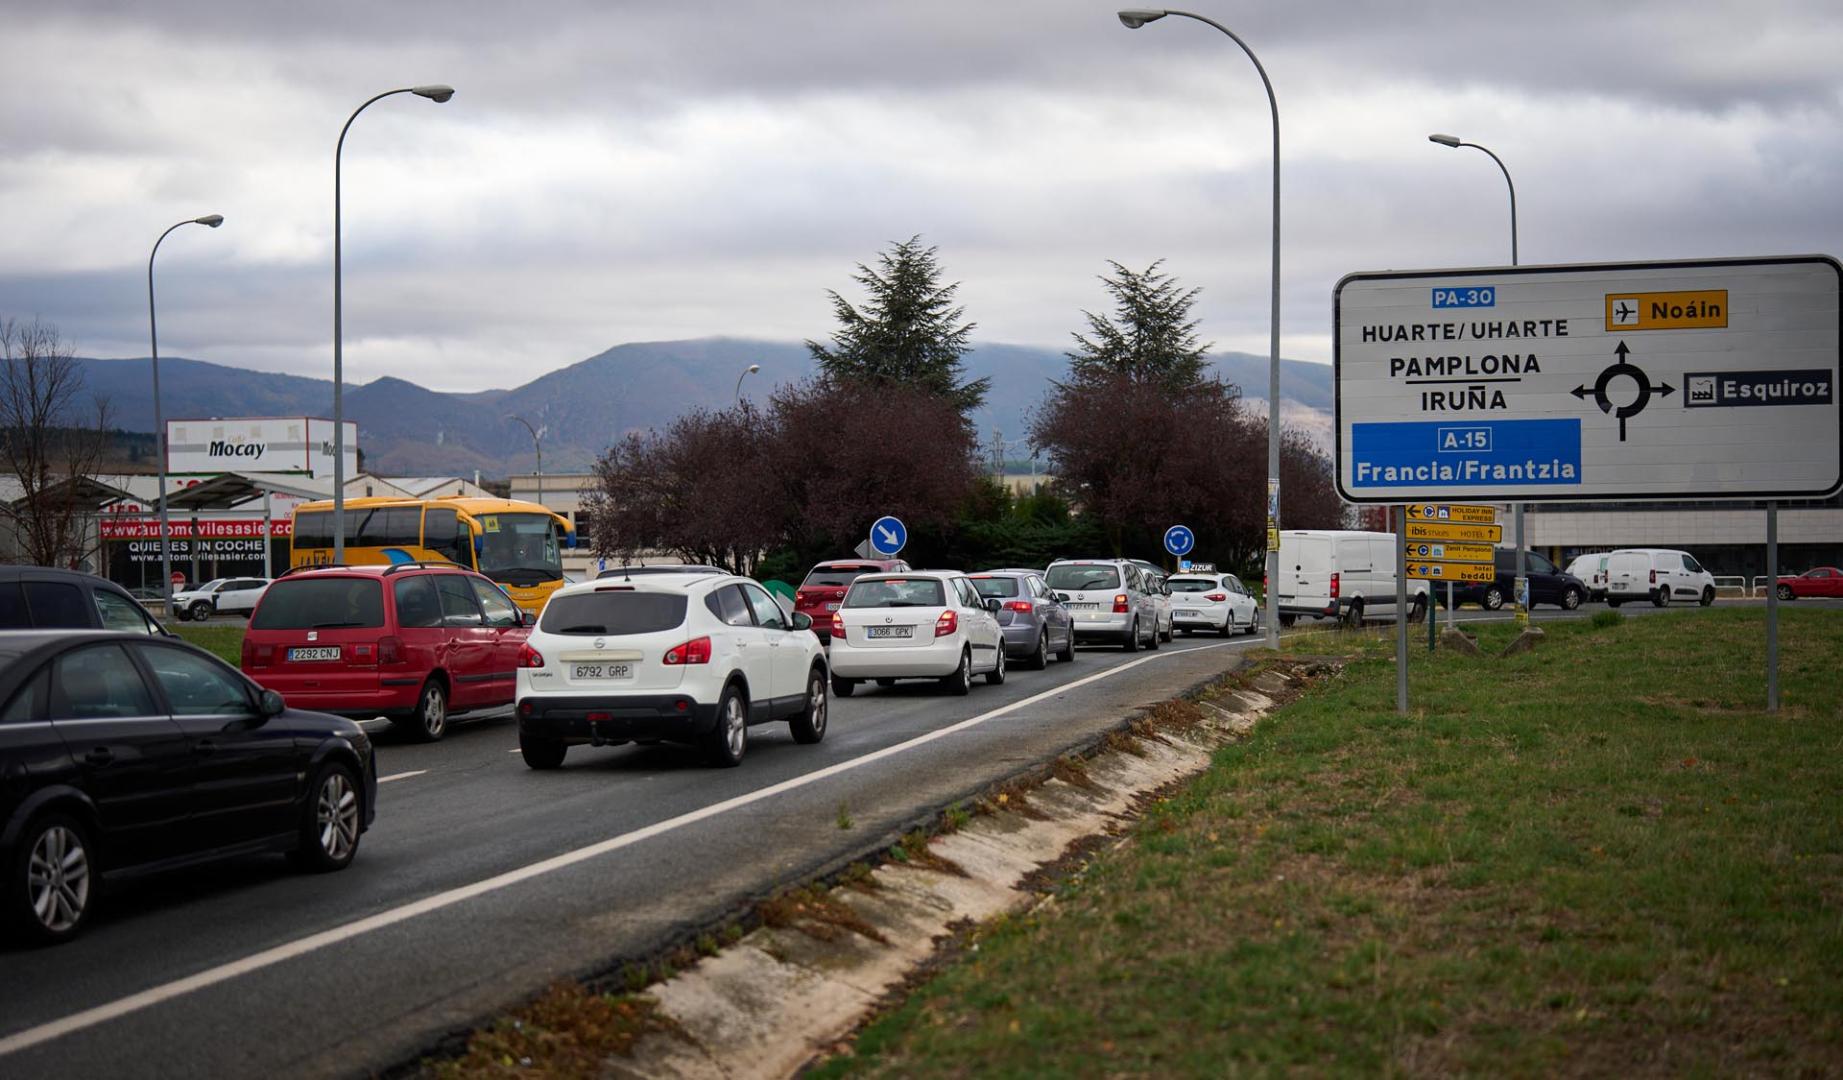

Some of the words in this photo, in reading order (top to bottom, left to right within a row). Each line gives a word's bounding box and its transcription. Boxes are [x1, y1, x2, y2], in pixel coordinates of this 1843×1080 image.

[1435, 290, 1492, 306] PA-30
[1651, 301, 1721, 319] Noáin
[1390, 354, 1541, 377] PAMPLONA
[1723, 379, 1829, 401] Esquiroz
[1421, 385, 1507, 411] IRUÑA
[1444, 431, 1487, 448] A-15
[209, 441, 265, 460] Mocay
[1452, 507, 1480, 515] HOLIDAY
[1411, 526, 1427, 536] ibis
[1461, 530, 1485, 538] HOTEL
[129, 541, 189, 552] QUIEES
[215, 541, 266, 551] COCHE
[1191, 563, 1213, 572] ZIZUR
[1461, 572, 1492, 580] bed4U
[873, 628, 891, 636] 3066
[295, 649, 318, 659] 2292
[320, 649, 339, 658] CNJ
[576, 666, 602, 677] 6792
[608, 665, 629, 676] GRP
